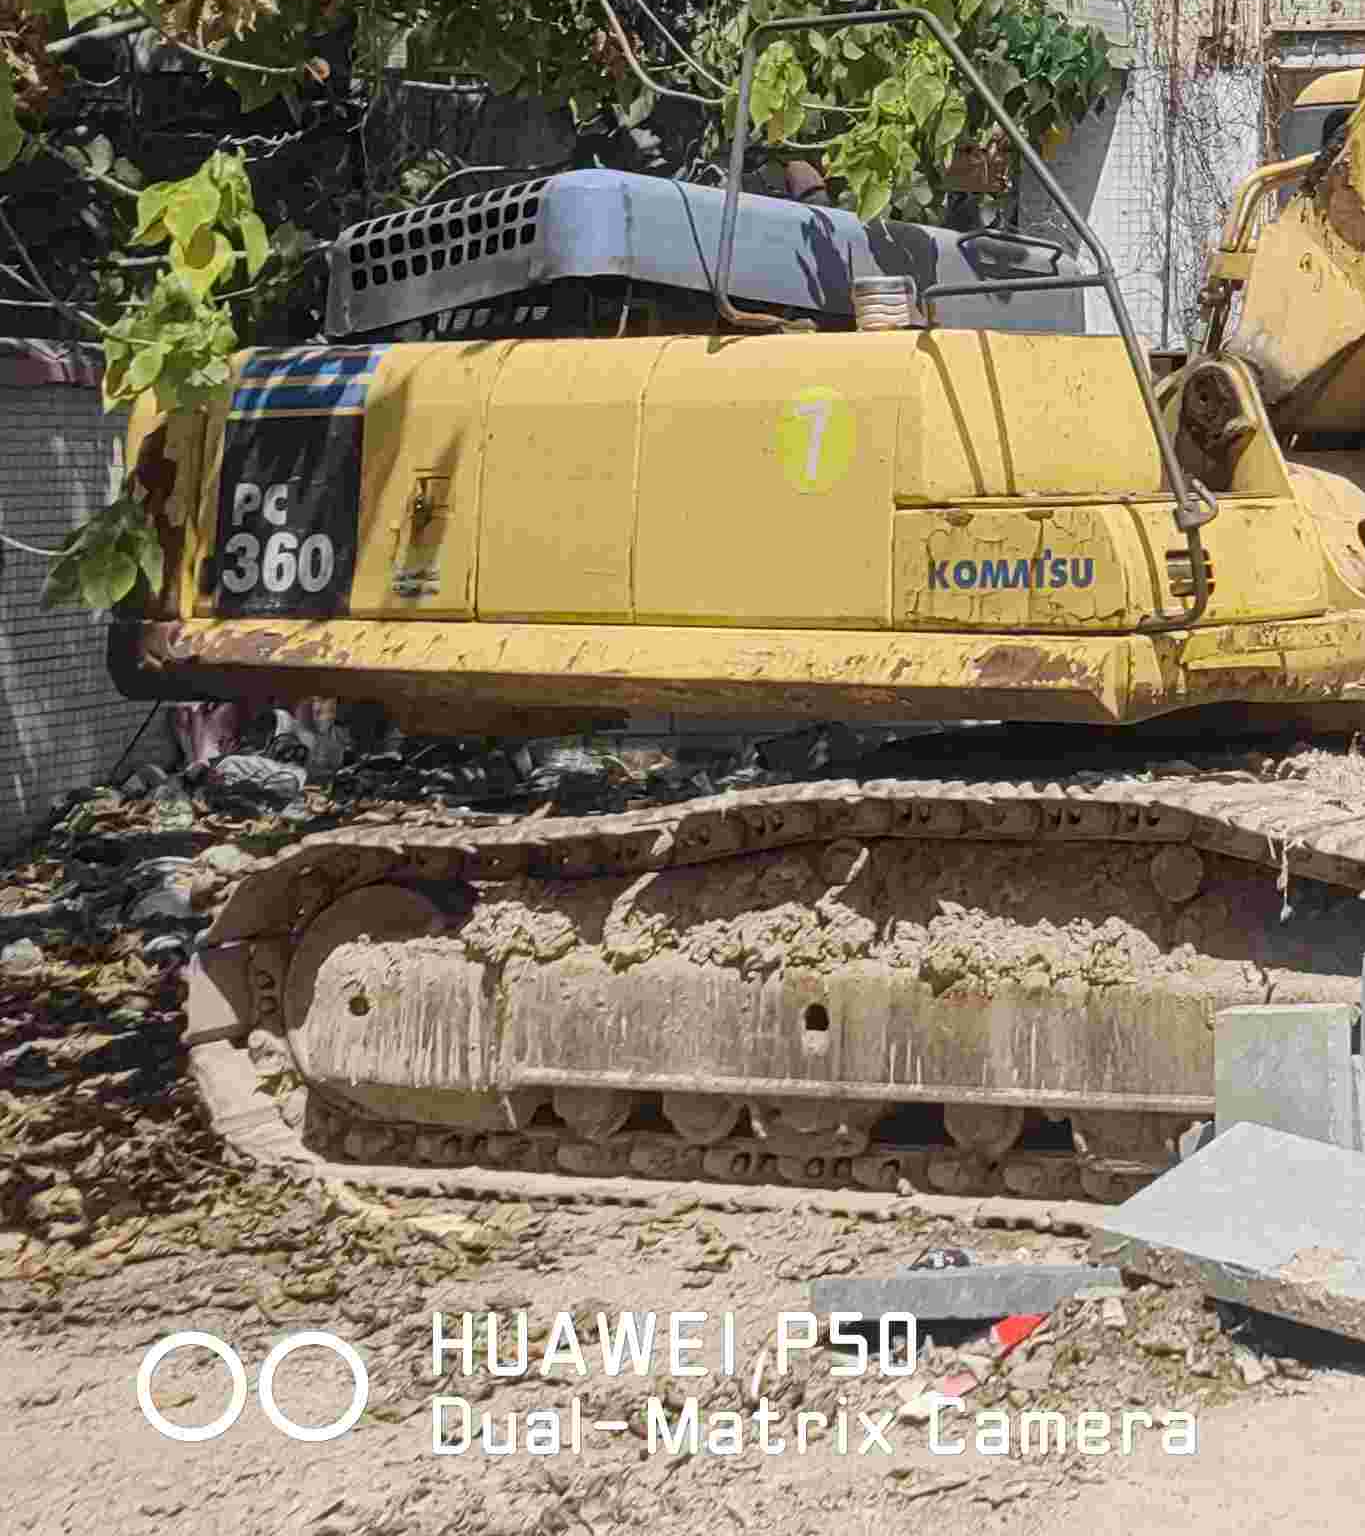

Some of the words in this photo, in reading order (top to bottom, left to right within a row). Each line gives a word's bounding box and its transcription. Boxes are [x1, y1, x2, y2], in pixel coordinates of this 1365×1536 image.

[793, 399, 830, 482] 7
[231, 482, 289, 526] PC
[221, 532, 335, 593] 360
[927, 548, 1095, 590] KOMATSU
